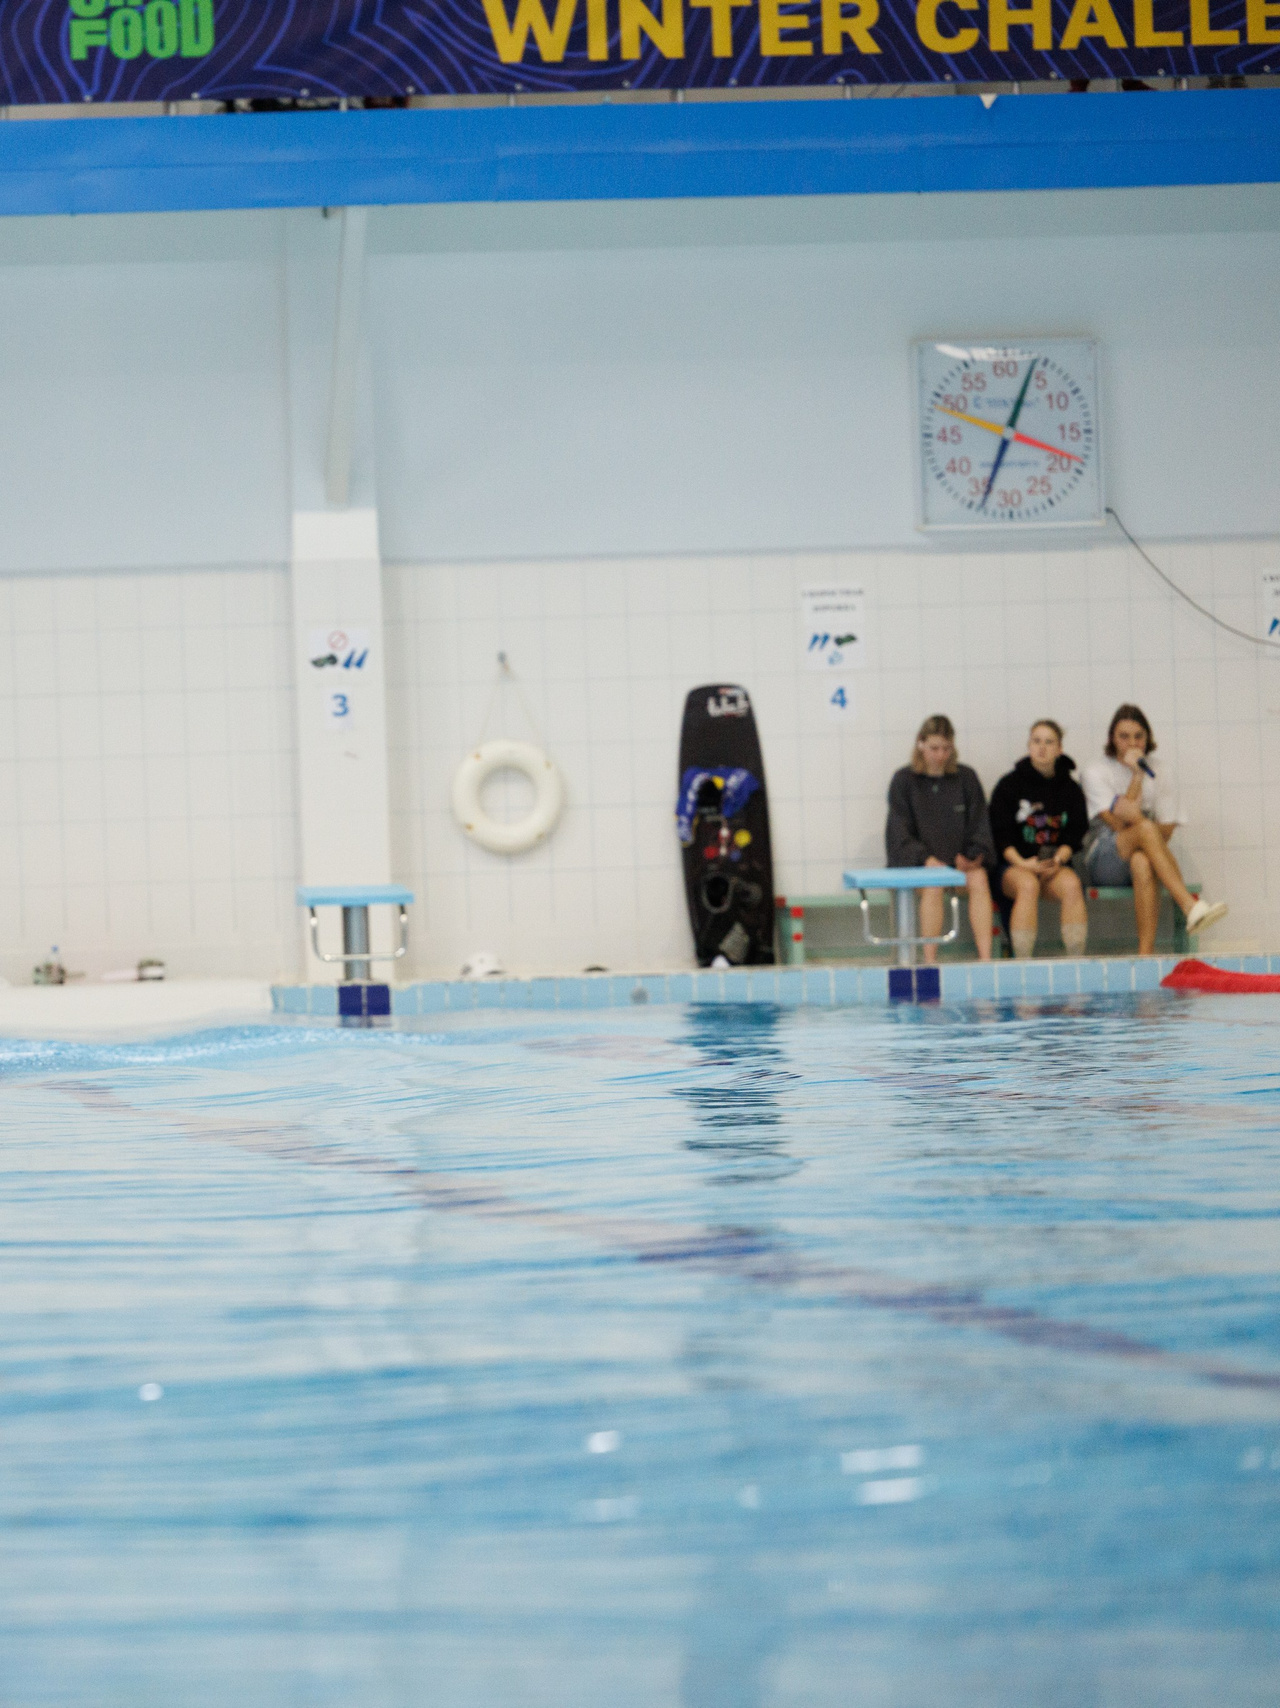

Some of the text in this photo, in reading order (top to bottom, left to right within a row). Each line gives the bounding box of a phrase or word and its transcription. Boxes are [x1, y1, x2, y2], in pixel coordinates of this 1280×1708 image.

[70, 0, 215, 60] FOOD
[482, 0, 1280, 64] WINTER CHALLE
[992, 360, 1018, 378] 60
[961, 372, 987, 392] 55
[1035, 371, 1048, 390] 5
[942, 394, 969, 413] 50
[1046, 391, 1070, 411] 10
[936, 425, 963, 445] 45
[1058, 422, 1082, 442] 15
[945, 456, 972, 475] 40
[1046, 453, 1072, 473] 20
[1026, 475, 1052, 496] 25
[997, 489, 1022, 508] 30
[332, 693, 350, 717] 3
[830, 686, 847, 709] 4
